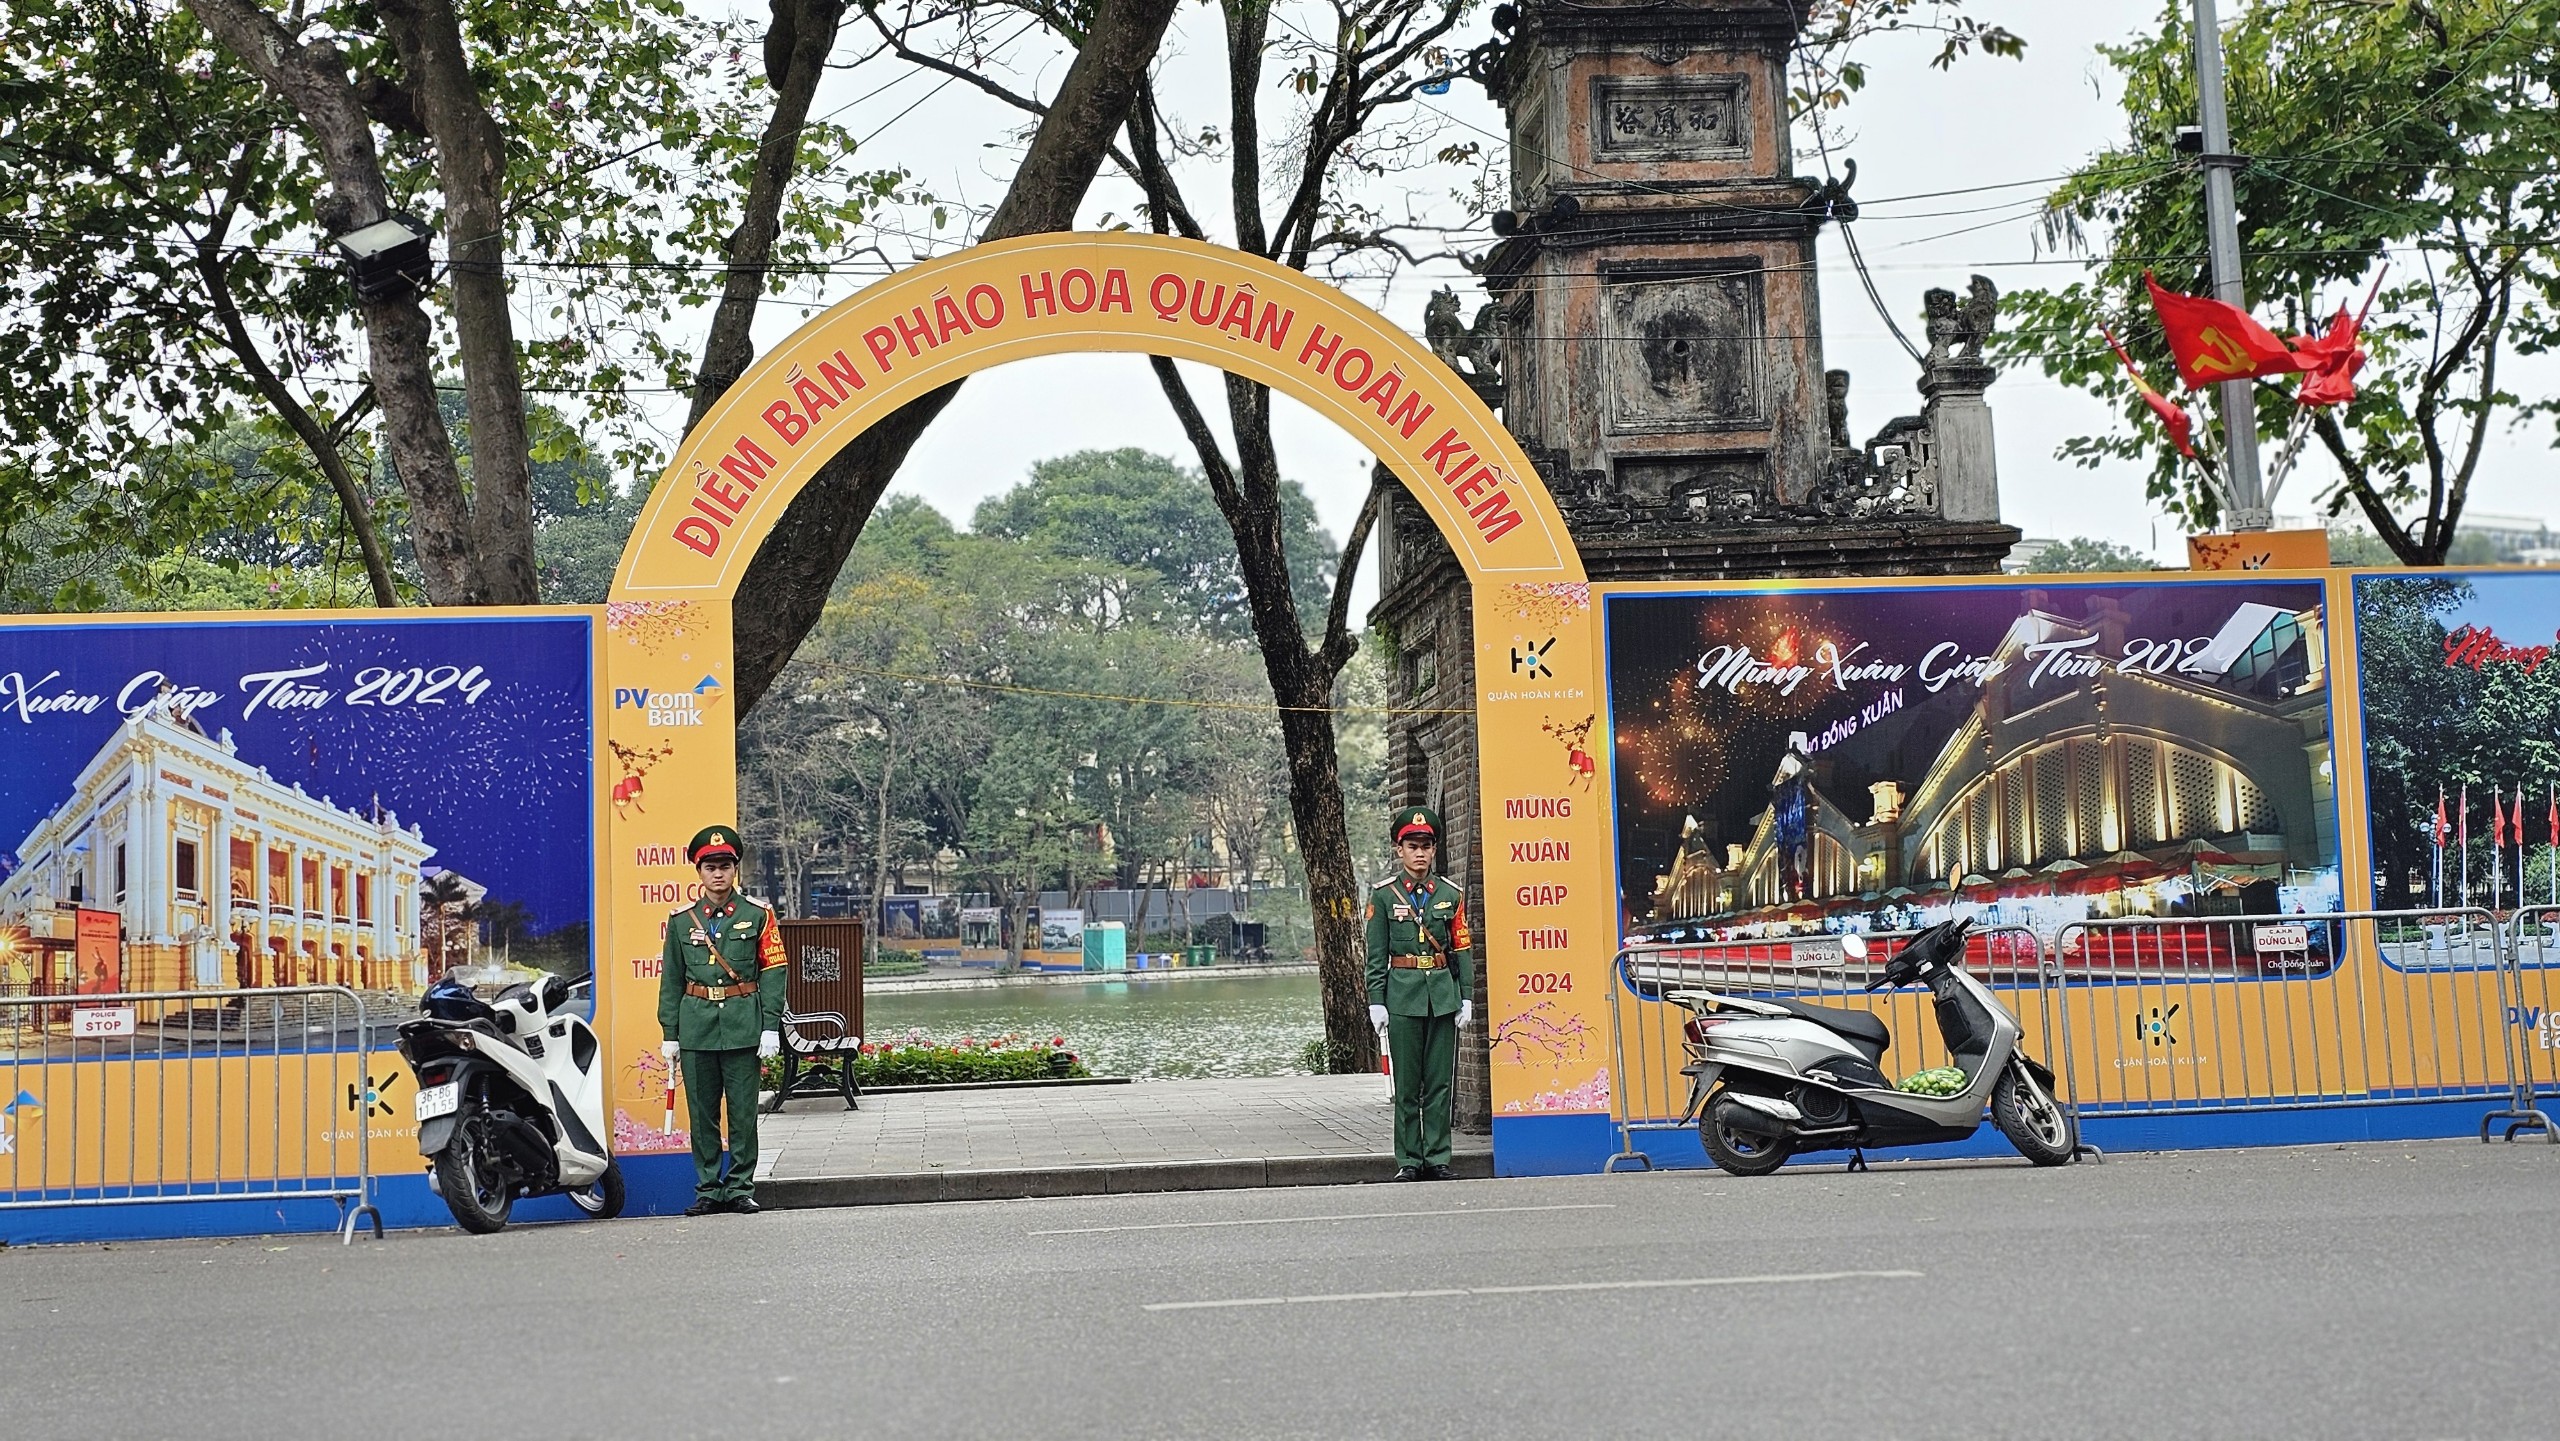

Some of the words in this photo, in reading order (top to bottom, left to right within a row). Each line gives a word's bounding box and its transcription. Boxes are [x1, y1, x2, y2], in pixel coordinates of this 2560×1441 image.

[672, 433, 778, 558] ĐIỂM
[761, 349, 867, 447] BẮN
[861, 284, 1005, 373] PHÁO
[1019, 267, 1133, 319] HOA
[1149, 273, 1295, 352] QUẬN
[1297, 322, 1436, 441] HOÀN
[1421, 427, 1524, 544] KIẾM
[1697, 645, 1815, 697] Mừng
[1815, 641, 1912, 691] Xuân
[1918, 641, 2012, 693] Giáp
[2024, 632, 2110, 689] Thìn
[0, 670, 109, 724] Xuân
[117, 670, 225, 725] Giáp
[239, 660, 339, 721] Thìn
[345, 665, 491, 706] 2024
[615, 688, 694, 710] PVcom
[1487, 689, 1517, 702] QUẬN
[1521, 688, 1551, 700] HOÀN
[1554, 687, 1584, 699] KIẾM
[648, 709, 703, 726] Bank
[1861, 687, 1903, 728] XUÂN
[1505, 794, 1571, 819] MỪNG
[636, 844, 675, 866] NĂM
[1510, 837, 1570, 863] XUÂN
[1516, 881, 1568, 907] GIÁP
[1518, 925, 1568, 950] THÌN
[2259, 935, 2287, 946] DỪNG
[2288, 936, 2304, 947] LẠI
[1518, 972, 1572, 994] 2024
[85, 1021, 122, 1032] STOP
[418, 1098, 455, 1118] 111.55
